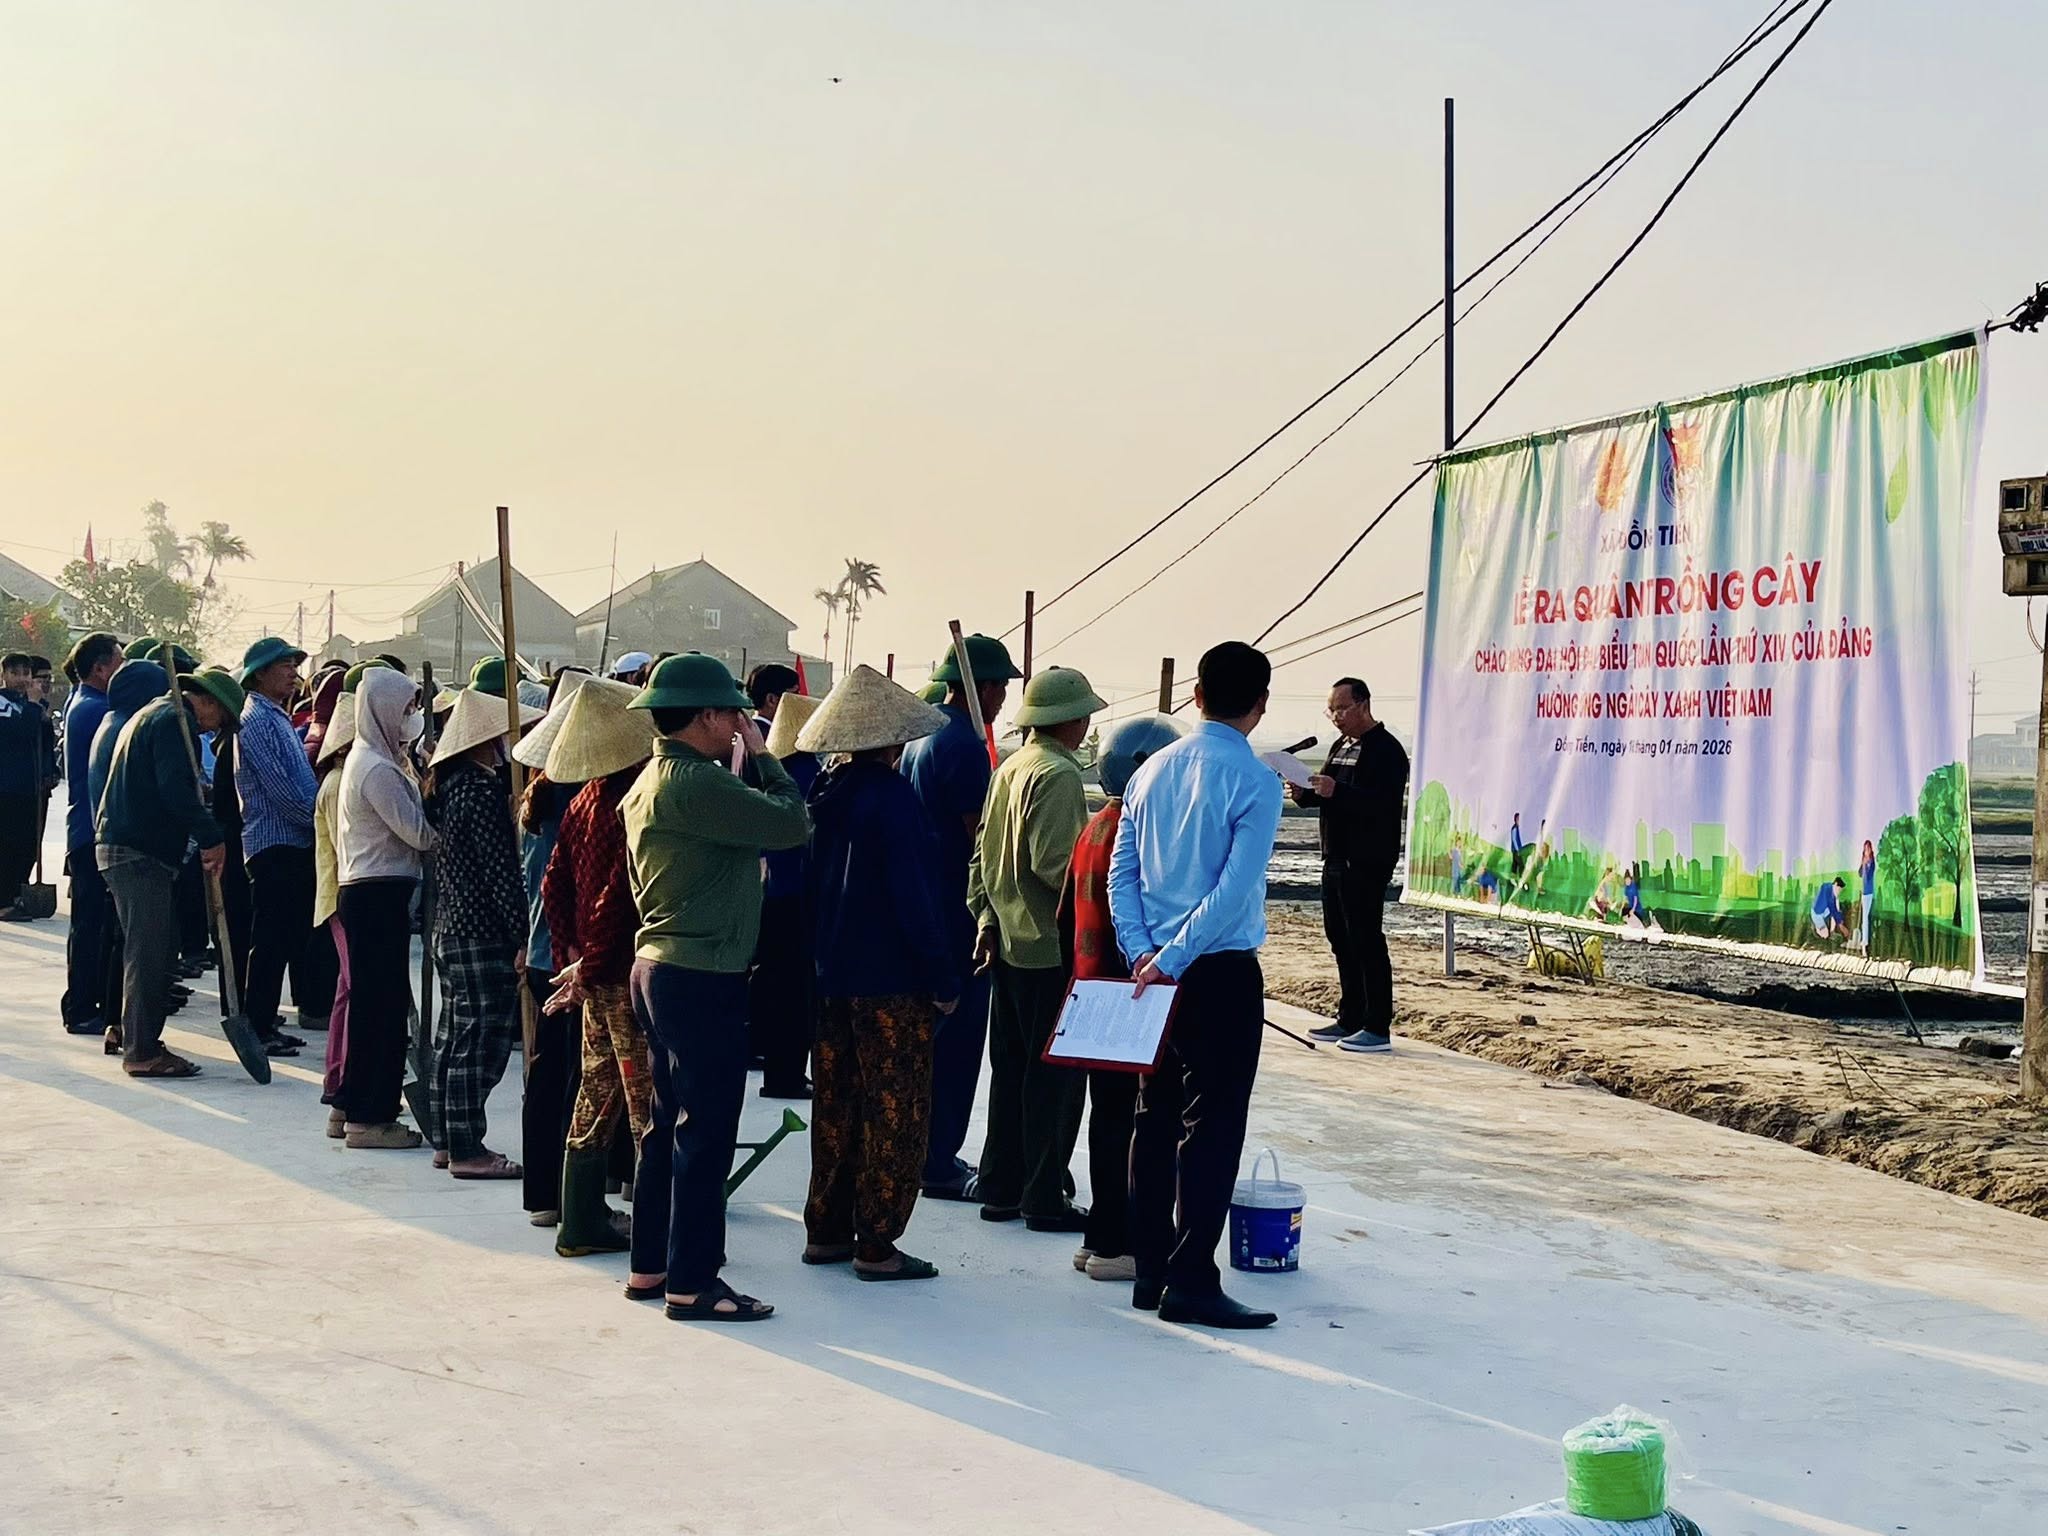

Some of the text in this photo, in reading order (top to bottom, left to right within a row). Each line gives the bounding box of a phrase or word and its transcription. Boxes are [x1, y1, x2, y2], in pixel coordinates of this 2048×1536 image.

[1534, 589, 1566, 624] RA
[1574, 572, 1644, 622] QUÂN
[1645, 554, 1744, 616] TRỒNG
[1752, 551, 1821, 607] CÂY
[1475, 642, 1506, 673] CHÀO
[1536, 647, 1557, 679] ĐẠI
[1560, 639, 1580, 679] HỘI
[1599, 628, 1628, 670] BIỂU
[1655, 627, 1696, 668] QUỐC
[1700, 622, 1731, 666] LẦN
[1736, 626, 1758, 664] THỨ
[1761, 633, 1786, 663] XIV
[1792, 619, 1825, 661] CỦA
[1828, 616, 1872, 658] ĐẢNG
[1662, 690, 1701, 718] XANH
[1706, 681, 1738, 727] VIỆT
[1740, 687, 1772, 717] NAM
[1601, 738, 1627, 757] ngày
[1659, 739, 1672, 754] 01
[1701, 739, 1733, 755] 2026
